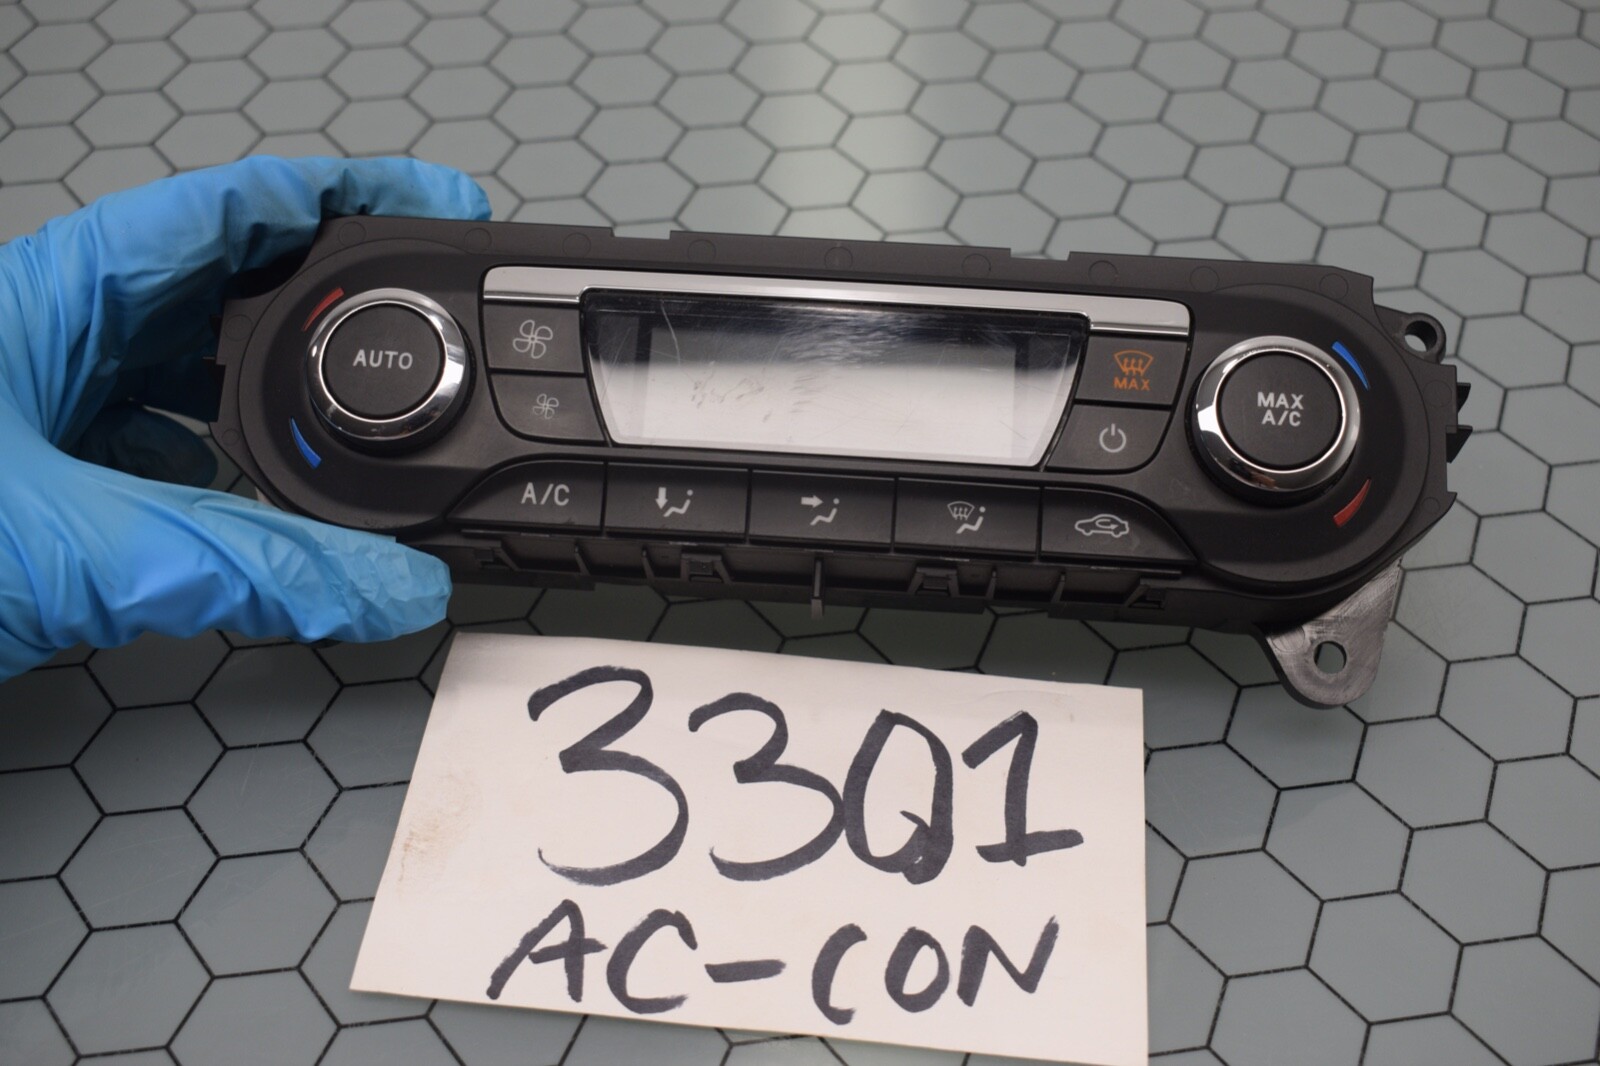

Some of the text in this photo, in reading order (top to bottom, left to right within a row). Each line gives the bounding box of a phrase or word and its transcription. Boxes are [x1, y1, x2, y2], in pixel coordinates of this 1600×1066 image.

[352, 348, 414, 370] AUTO
[1113, 376, 1151, 391] MAX
[1256, 391, 1304, 411] MAX
[1261, 409, 1302, 428] A/C
[520, 481, 570, 507] A/C
[486, 898, 1060, 1025] AC-CON
